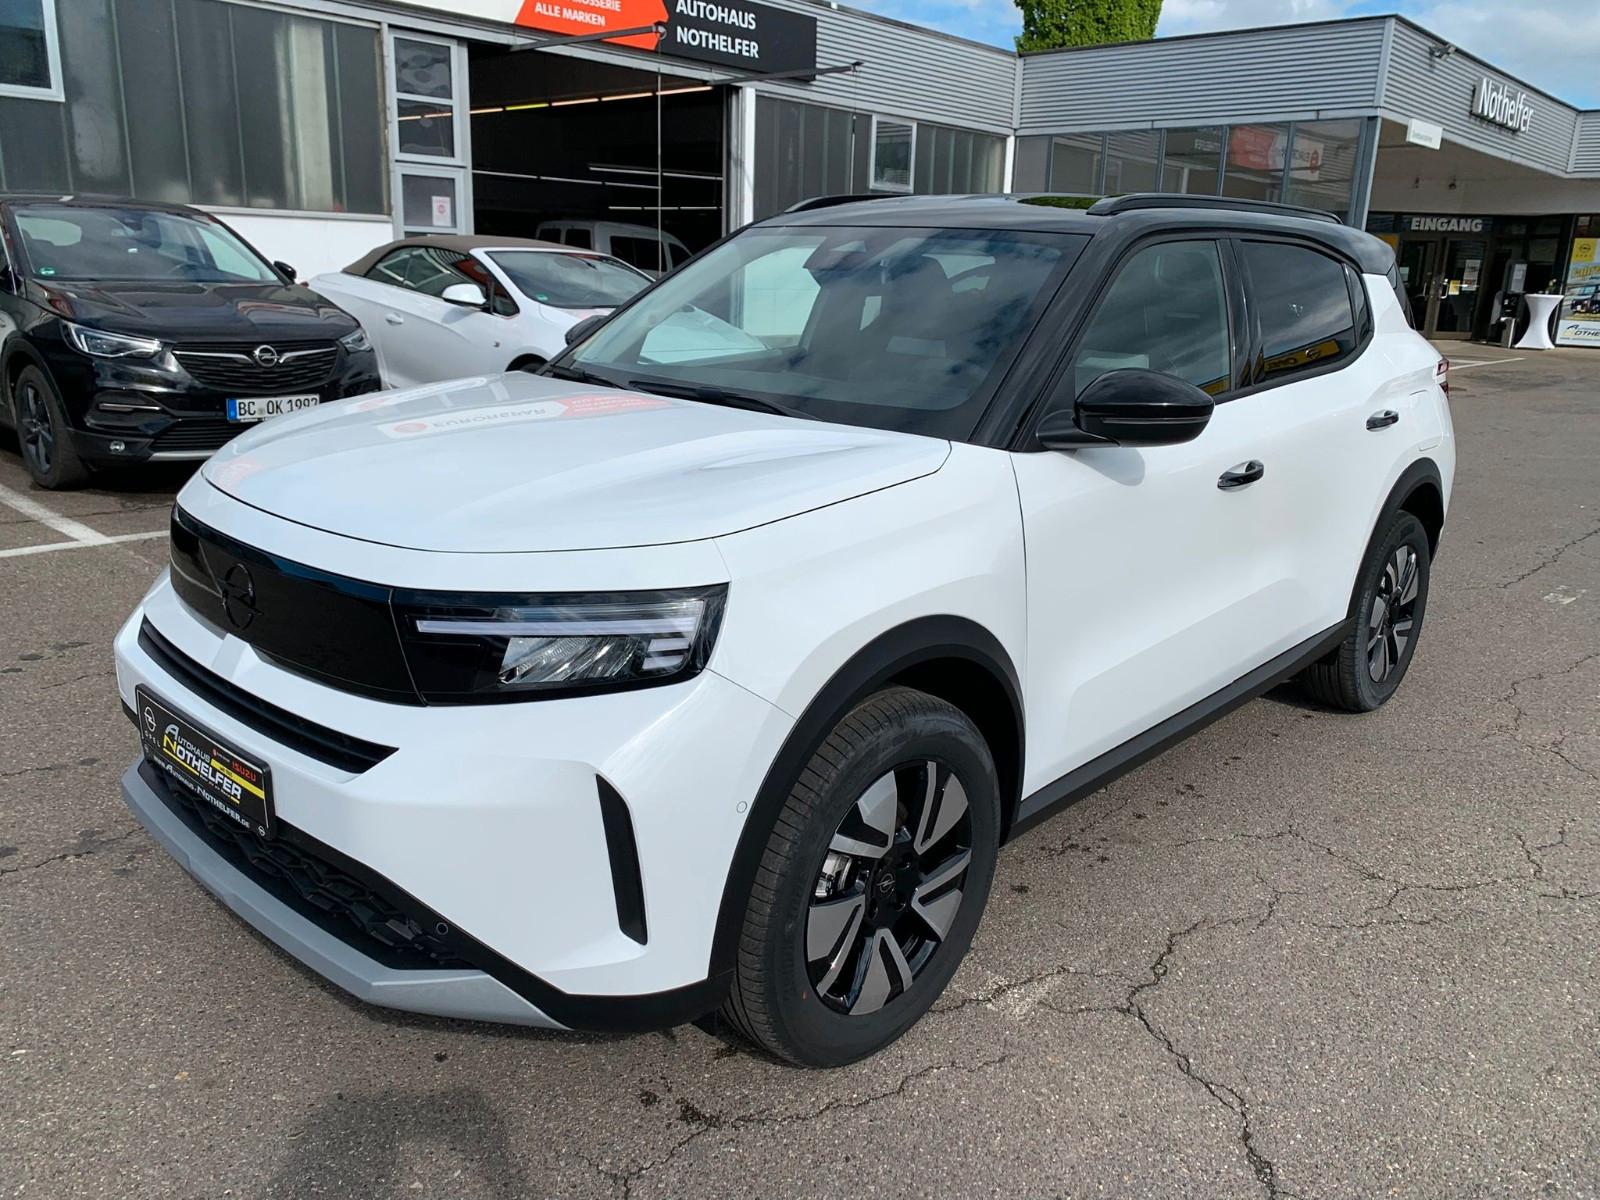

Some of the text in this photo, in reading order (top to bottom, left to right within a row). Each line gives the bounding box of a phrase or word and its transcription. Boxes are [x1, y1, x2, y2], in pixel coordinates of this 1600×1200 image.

[535, 2, 606, 26] ALLE MARKEN
[571, 0, 621, 12] SSERIE
[676, 0, 756, 30] AUTOHAUS
[676, 25, 760, 59] NOTHELFER
[1478, 77, 1535, 134] Nothelfer
[1410, 217, 1484, 232] EINGANG
[238, 401, 256, 416] BC
[266, 400, 283, 415] OK
[163, 734, 242, 800] NOTHELFER
[232, 760, 257, 782] ISUZU
